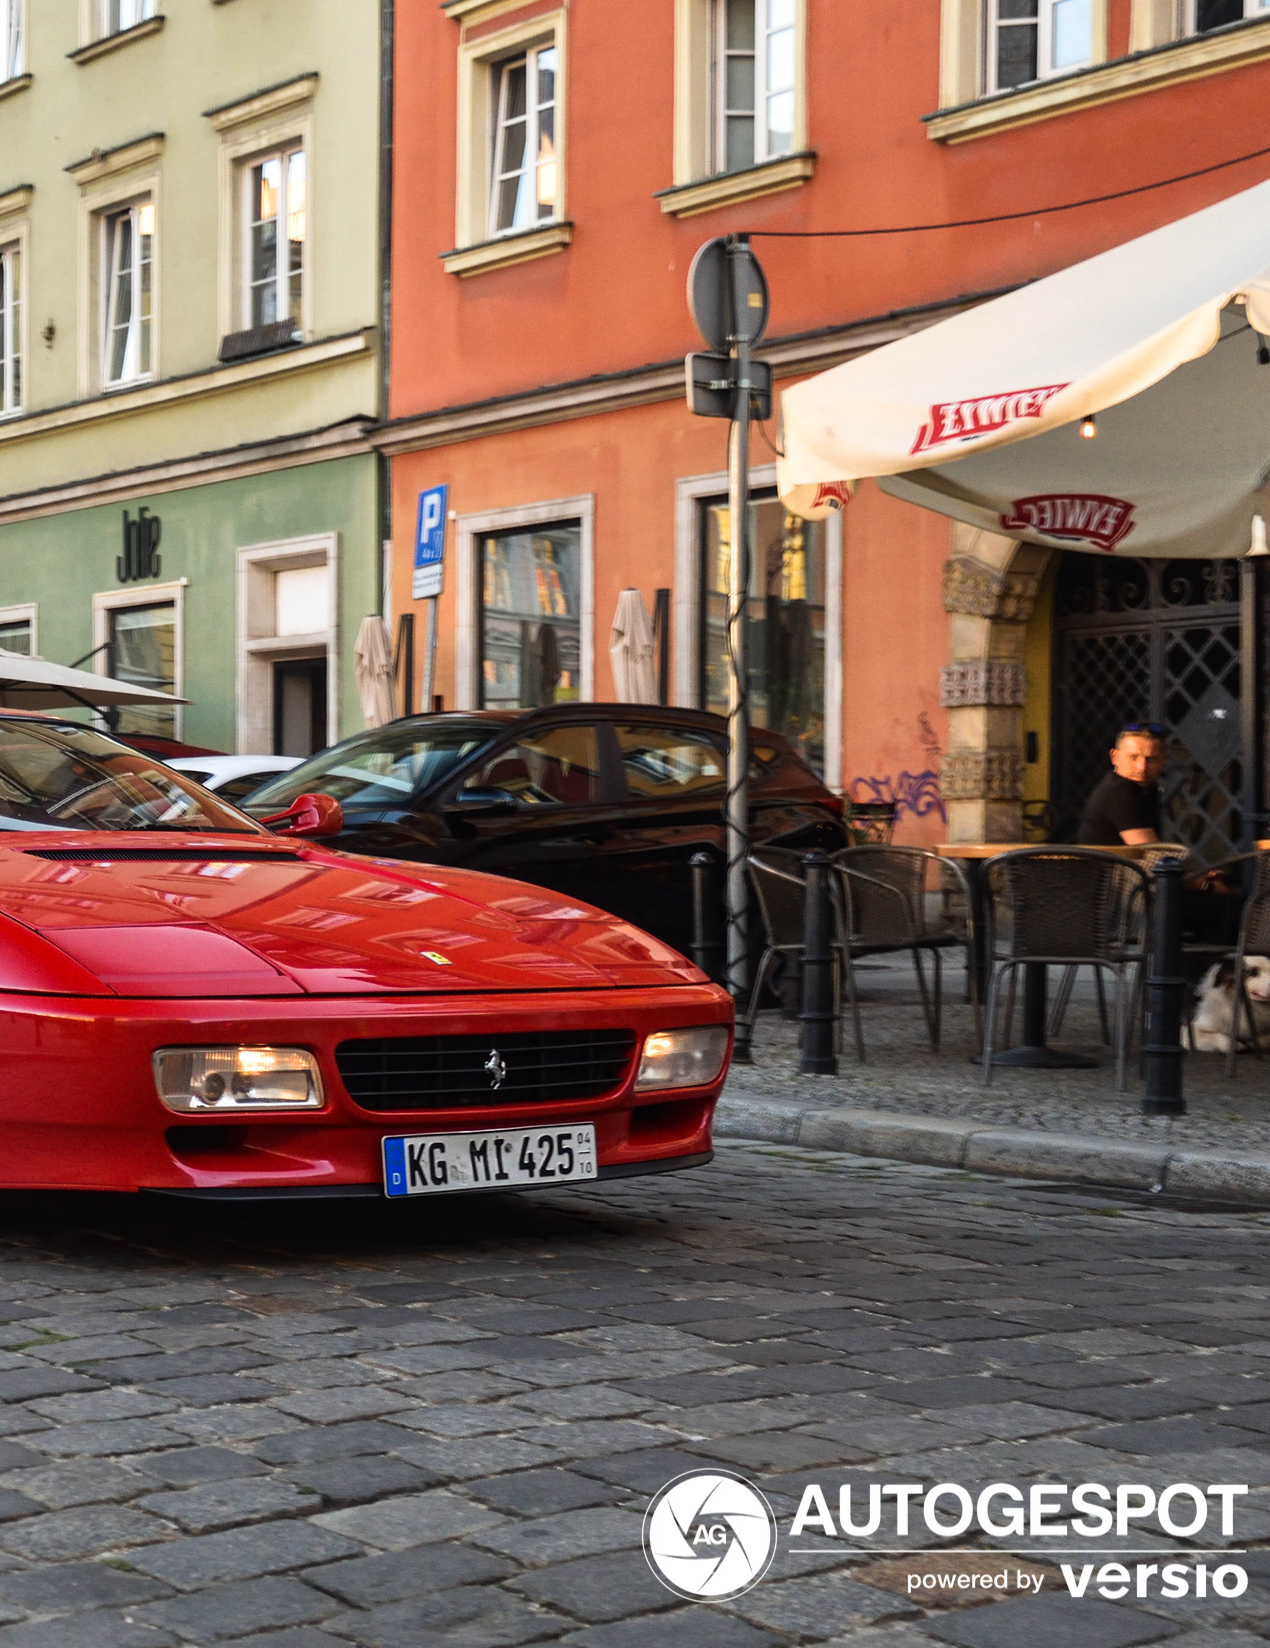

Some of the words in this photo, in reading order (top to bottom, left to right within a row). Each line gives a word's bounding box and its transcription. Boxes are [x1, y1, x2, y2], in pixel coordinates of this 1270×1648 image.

[420, 493, 442, 544] P
[577, 1131, 591, 1145] 04
[407, 1142, 448, 1187] KG
[469, 1138, 510, 1182] MI
[518, 1133, 574, 1178] 425
[579, 1161, 592, 1174] 10
[392, 1172, 401, 1185] D
